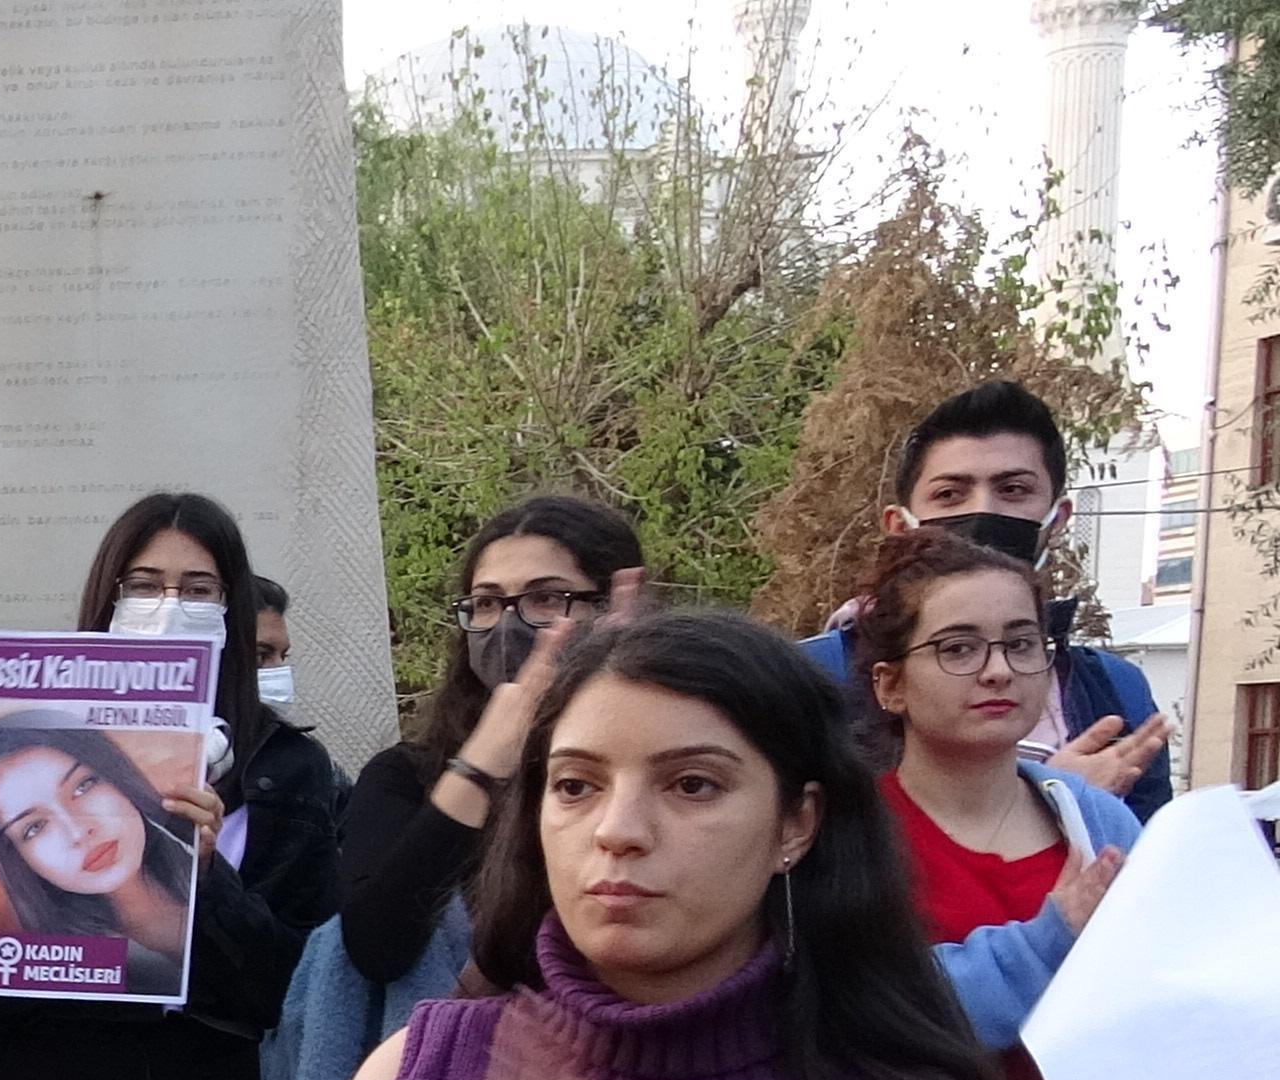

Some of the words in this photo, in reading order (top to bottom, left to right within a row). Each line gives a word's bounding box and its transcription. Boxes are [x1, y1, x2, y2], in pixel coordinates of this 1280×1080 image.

[42, 655, 197, 695] Kalmıyoruz!
[23, 944, 83, 962] KADIN
[23, 962, 122, 985] MECLİSLERİ
